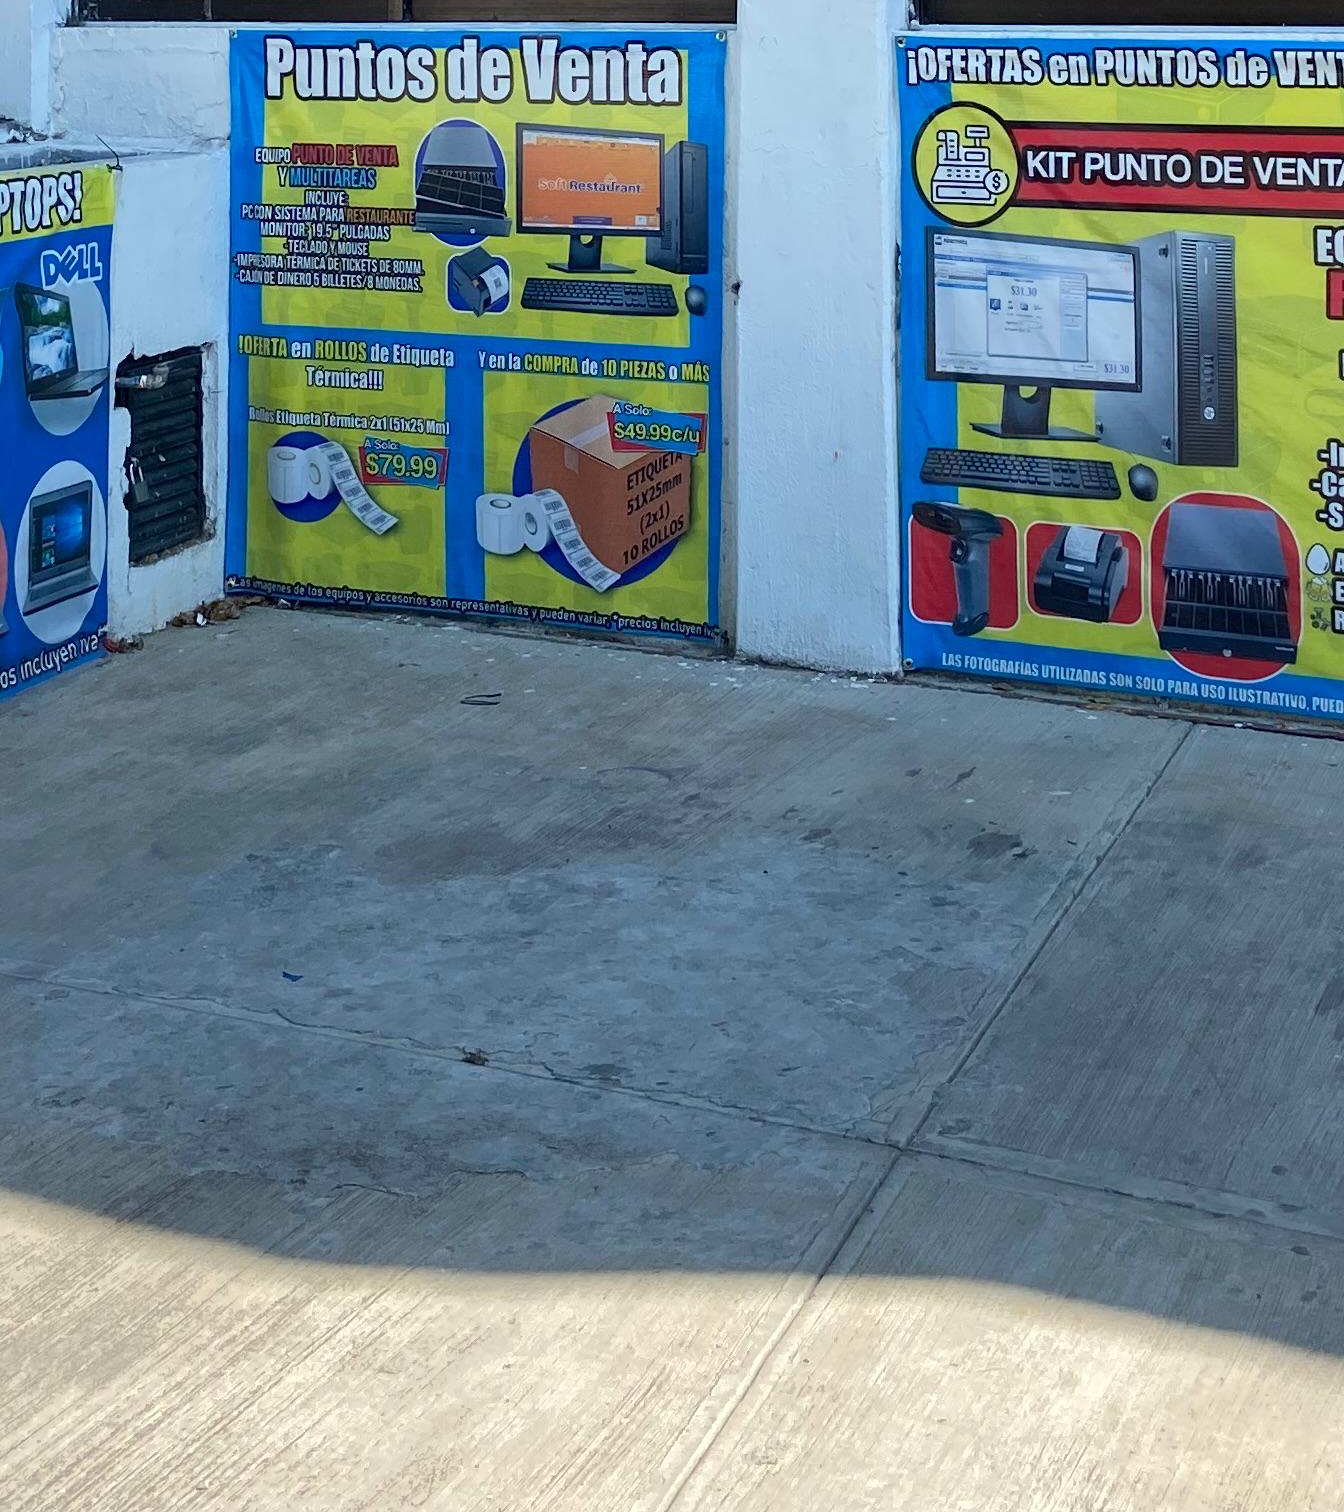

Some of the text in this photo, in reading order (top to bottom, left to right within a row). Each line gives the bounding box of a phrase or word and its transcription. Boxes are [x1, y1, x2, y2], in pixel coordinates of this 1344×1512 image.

[264, 35, 682, 106] Puntos de Venta
[906, 46, 1043, 86] ¡OFERTAS
[1048, 51, 1090, 85] en
[1094, 48, 1219, 86] PUNTOS
[1226, 51, 1269, 87] de
[256, 144, 399, 167] EQUIPO PUNTO DE VENTA
[1026, 150, 1076, 180] KIT
[1084, 152, 1192, 183] PUNTO
[1200, 156, 1245, 185] DE
[278, 167, 376, 188] Y MULTITAREAS
[538, 178, 642, 195] Soft Restaurant
[305, 190, 349, 205] INCLUYE:
[242, 205, 415, 225] PC CON SISTEMA PARA RESTAURANTE
[41, 242, 104, 290] DELL
[291, 341, 311, 358] en
[315, 340, 367, 361] ROLLOS
[370, 343, 390, 363] de
[392, 344, 454, 367] Etiqueta
[306, 366, 383, 389] Térmica!!!
[364, 439, 372, 448] A
[614, 422, 700, 443] $49.99c/u
[365, 453, 437, 479] $79.99
[627, 452, 682, 490] ETIQUETA
[627, 472, 682, 516] 51X25mm
[640, 501, 670, 535] (2x1)
[623, 515, 684, 565] 10 ROLLOS
[20, 642, 77, 680] incluyen
